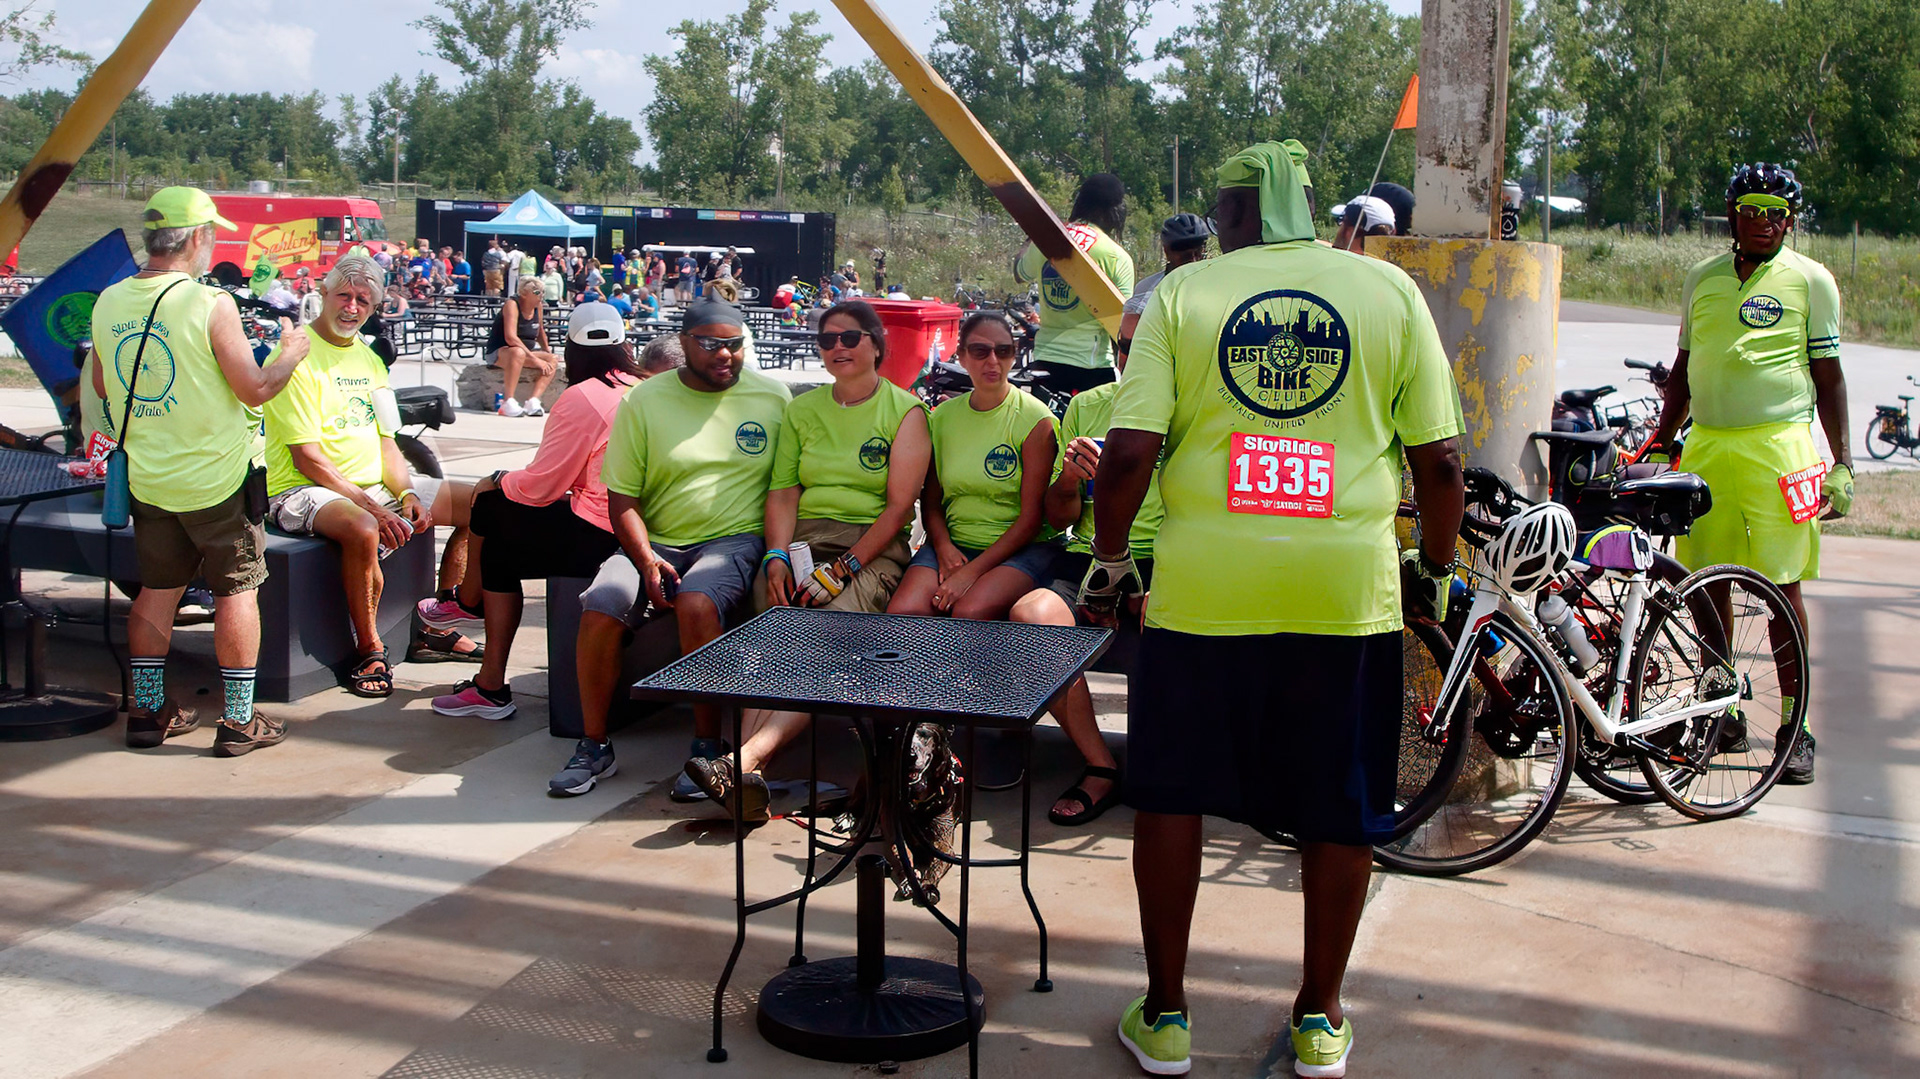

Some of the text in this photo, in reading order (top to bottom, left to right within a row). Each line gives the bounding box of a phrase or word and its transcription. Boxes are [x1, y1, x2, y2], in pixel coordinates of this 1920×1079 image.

[1230, 347, 1339, 365] EAST SIDE
[1257, 363, 1312, 389] BIKE
[1217, 386, 1346, 429] BUFFALO UNITED FRONT
[1258, 391, 1307, 402] CLUB
[1243, 435, 1323, 456] SkyRide
[1234, 453, 1331, 497] 1335
